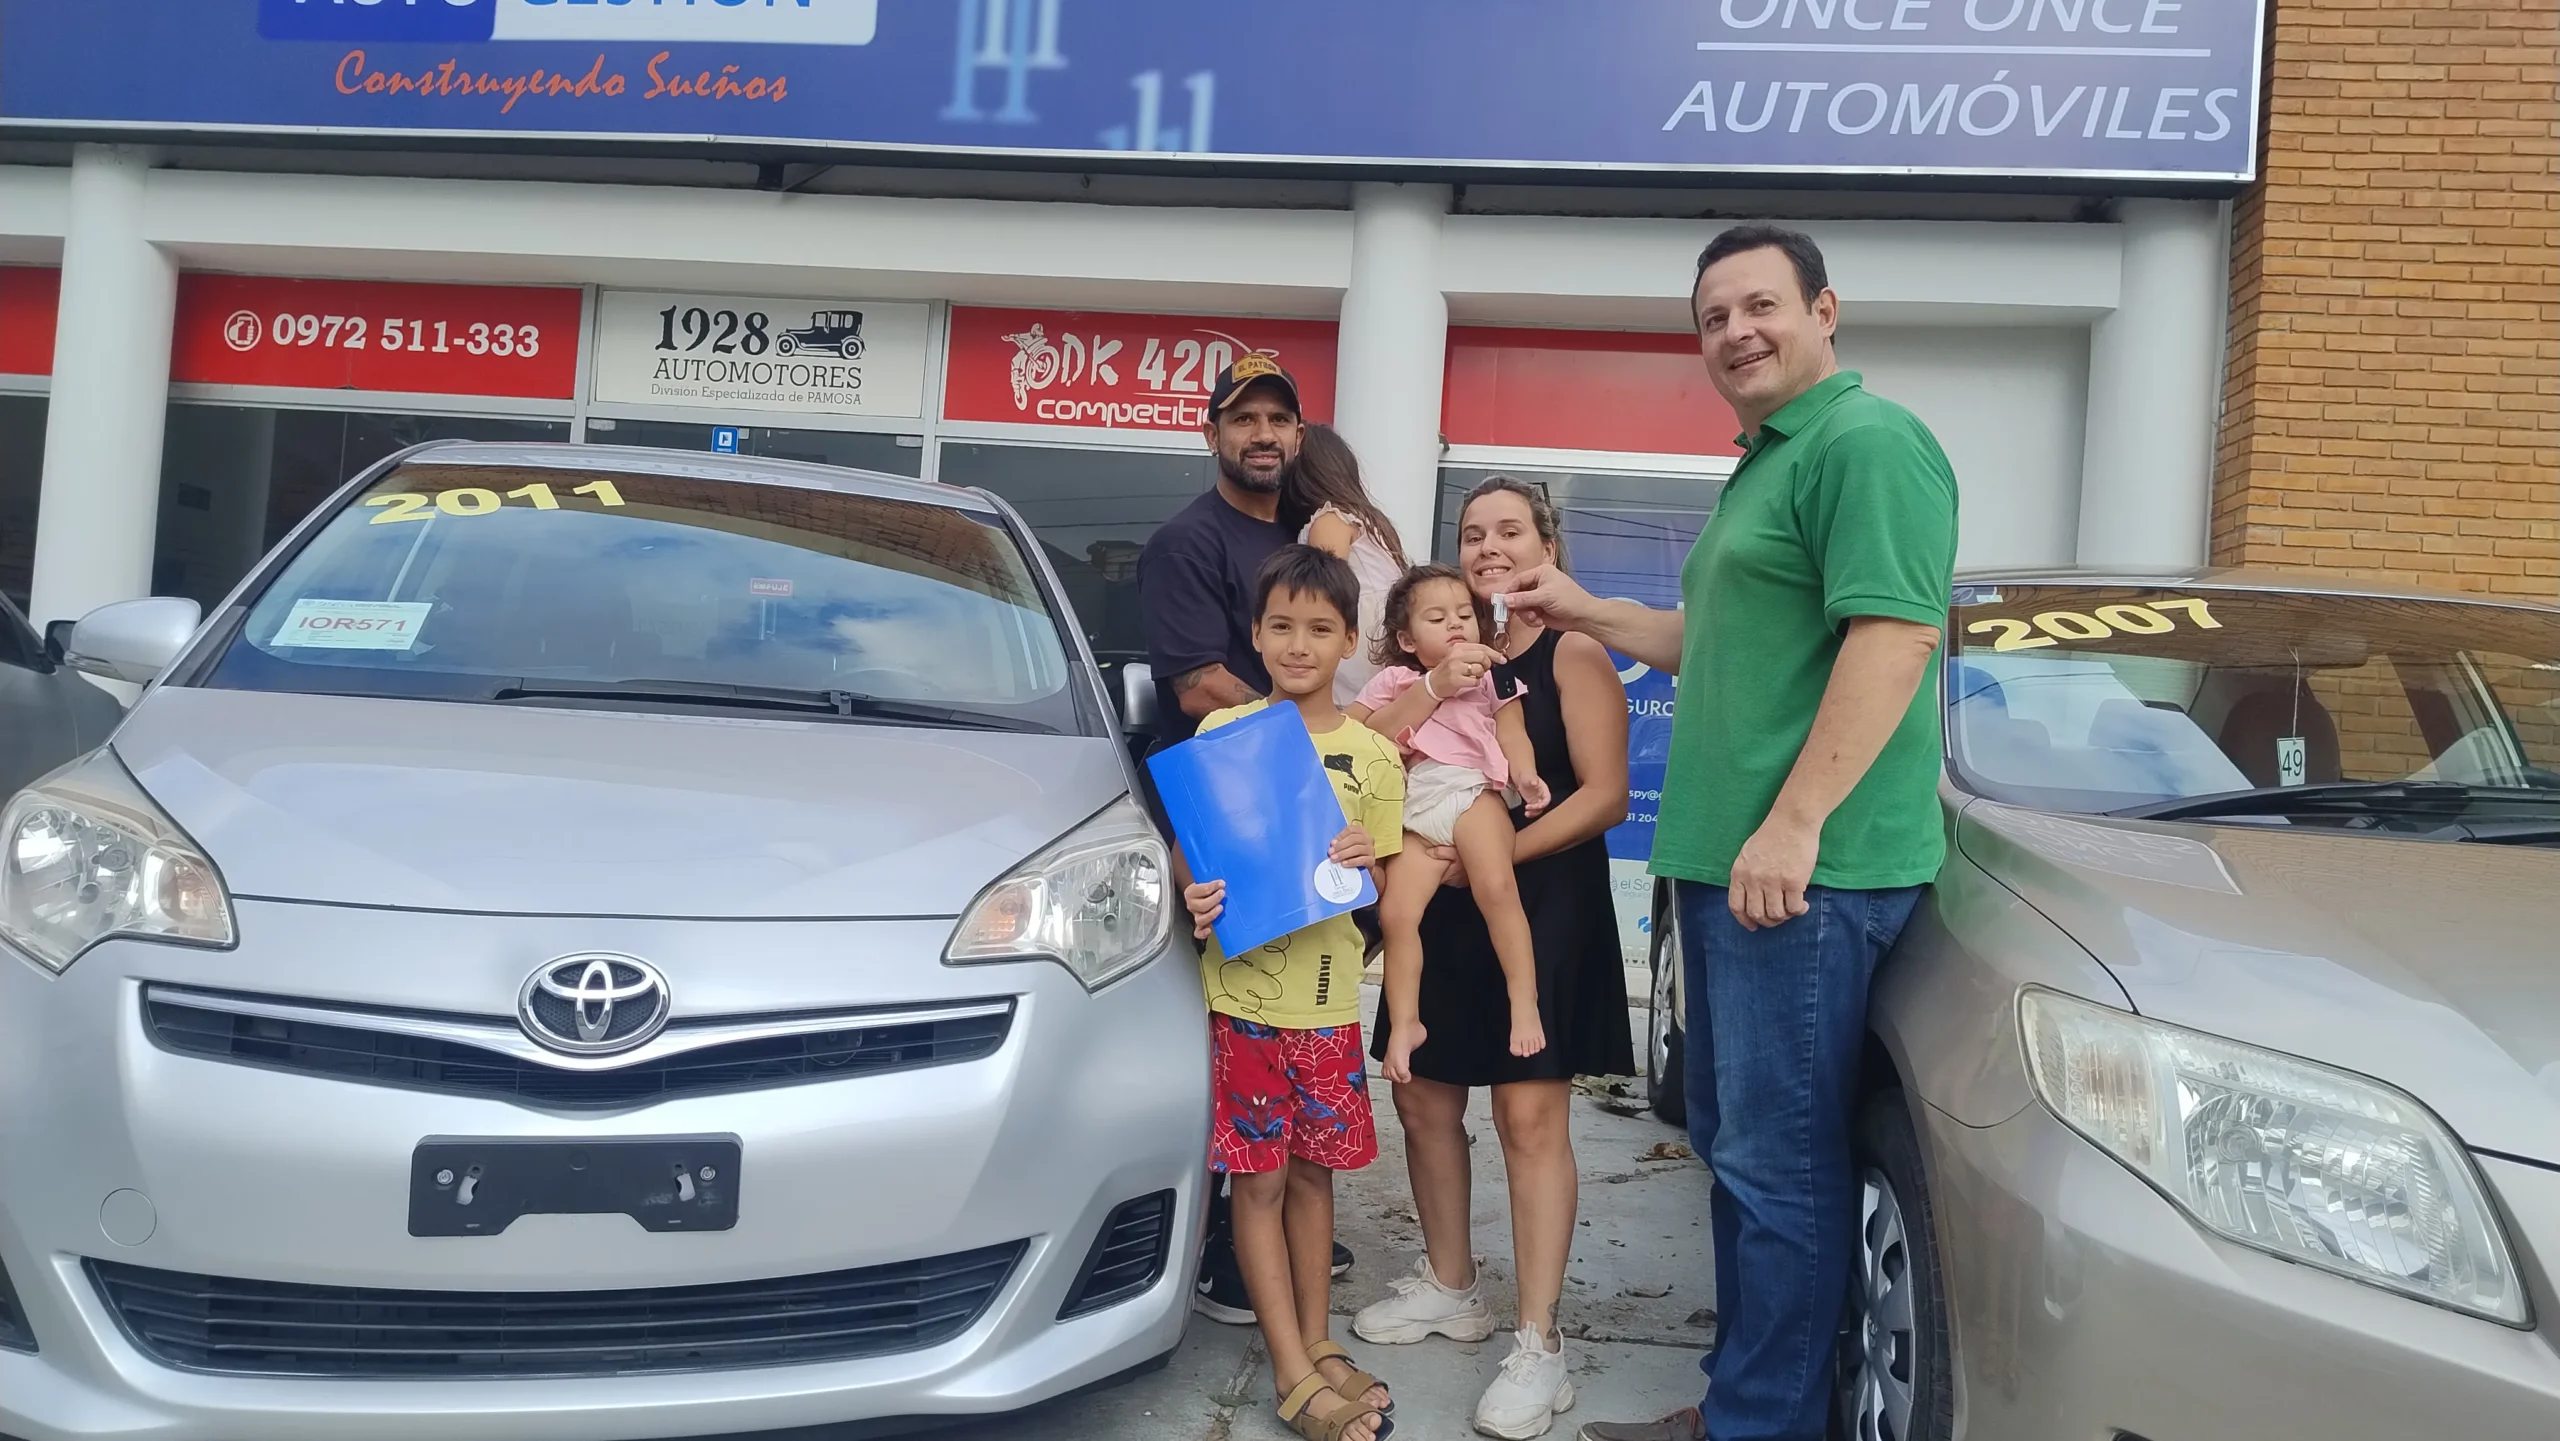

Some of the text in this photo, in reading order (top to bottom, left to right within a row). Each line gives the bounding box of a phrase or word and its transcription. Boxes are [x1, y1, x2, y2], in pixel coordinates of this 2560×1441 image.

[1719, 0, 2183, 34] ONCE ONCE
[334, 49, 788, 114] Construyendo Sueños
[1661, 70, 2239, 142] AUTOMÓVILES
[272, 312, 540, 358] 0972 511-333
[654, 304, 771, 356] 1928
[652, 357, 863, 390] AUTOMOTORES
[1060, 332, 1234, 393] DK 420
[650, 383, 863, 405] División Especializada de PAMOSA
[364, 480, 626, 525] 2011
[299, 616, 407, 632] IOR571
[1967, 598, 2224, 653] 2007
[2282, 749, 2303, 777] 49
[1620, 878, 1631, 890] el
